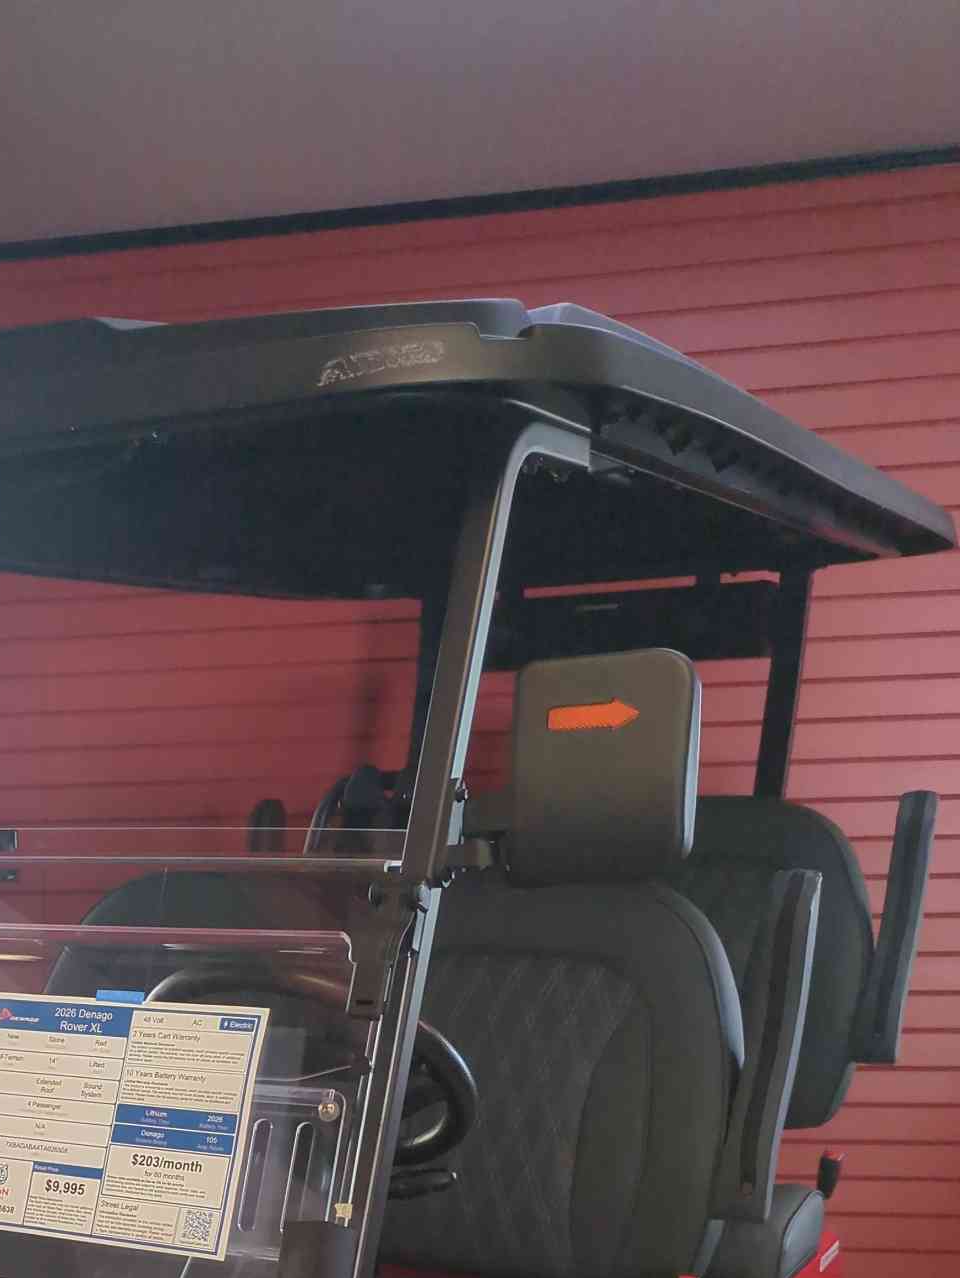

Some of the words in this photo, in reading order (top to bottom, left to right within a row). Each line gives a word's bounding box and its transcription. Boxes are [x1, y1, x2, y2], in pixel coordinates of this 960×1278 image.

[54, 1007, 77, 1018] 2026
[78, 1008, 113, 1022] Denago
[59, 1020, 89, 1032] Rover
[89, 1023, 103, 1033] XL
[229, 1020, 254, 1029] Electric
[139, 1030, 156, 1039] Years
[158, 1031, 171, 1040] Cart
[172, 1032, 201, 1043] Warranty
[134, 1070, 154, 1078] Years
[154, 1071, 177, 1081] Battery
[178, 1073, 207, 1083] Warranty
[32, 1101, 62, 1111] Passenger
[131, 1153, 203, 1173] $203/month
[162, 1172, 185, 1181] months
[45, 1179, 86, 1196] $9,995
